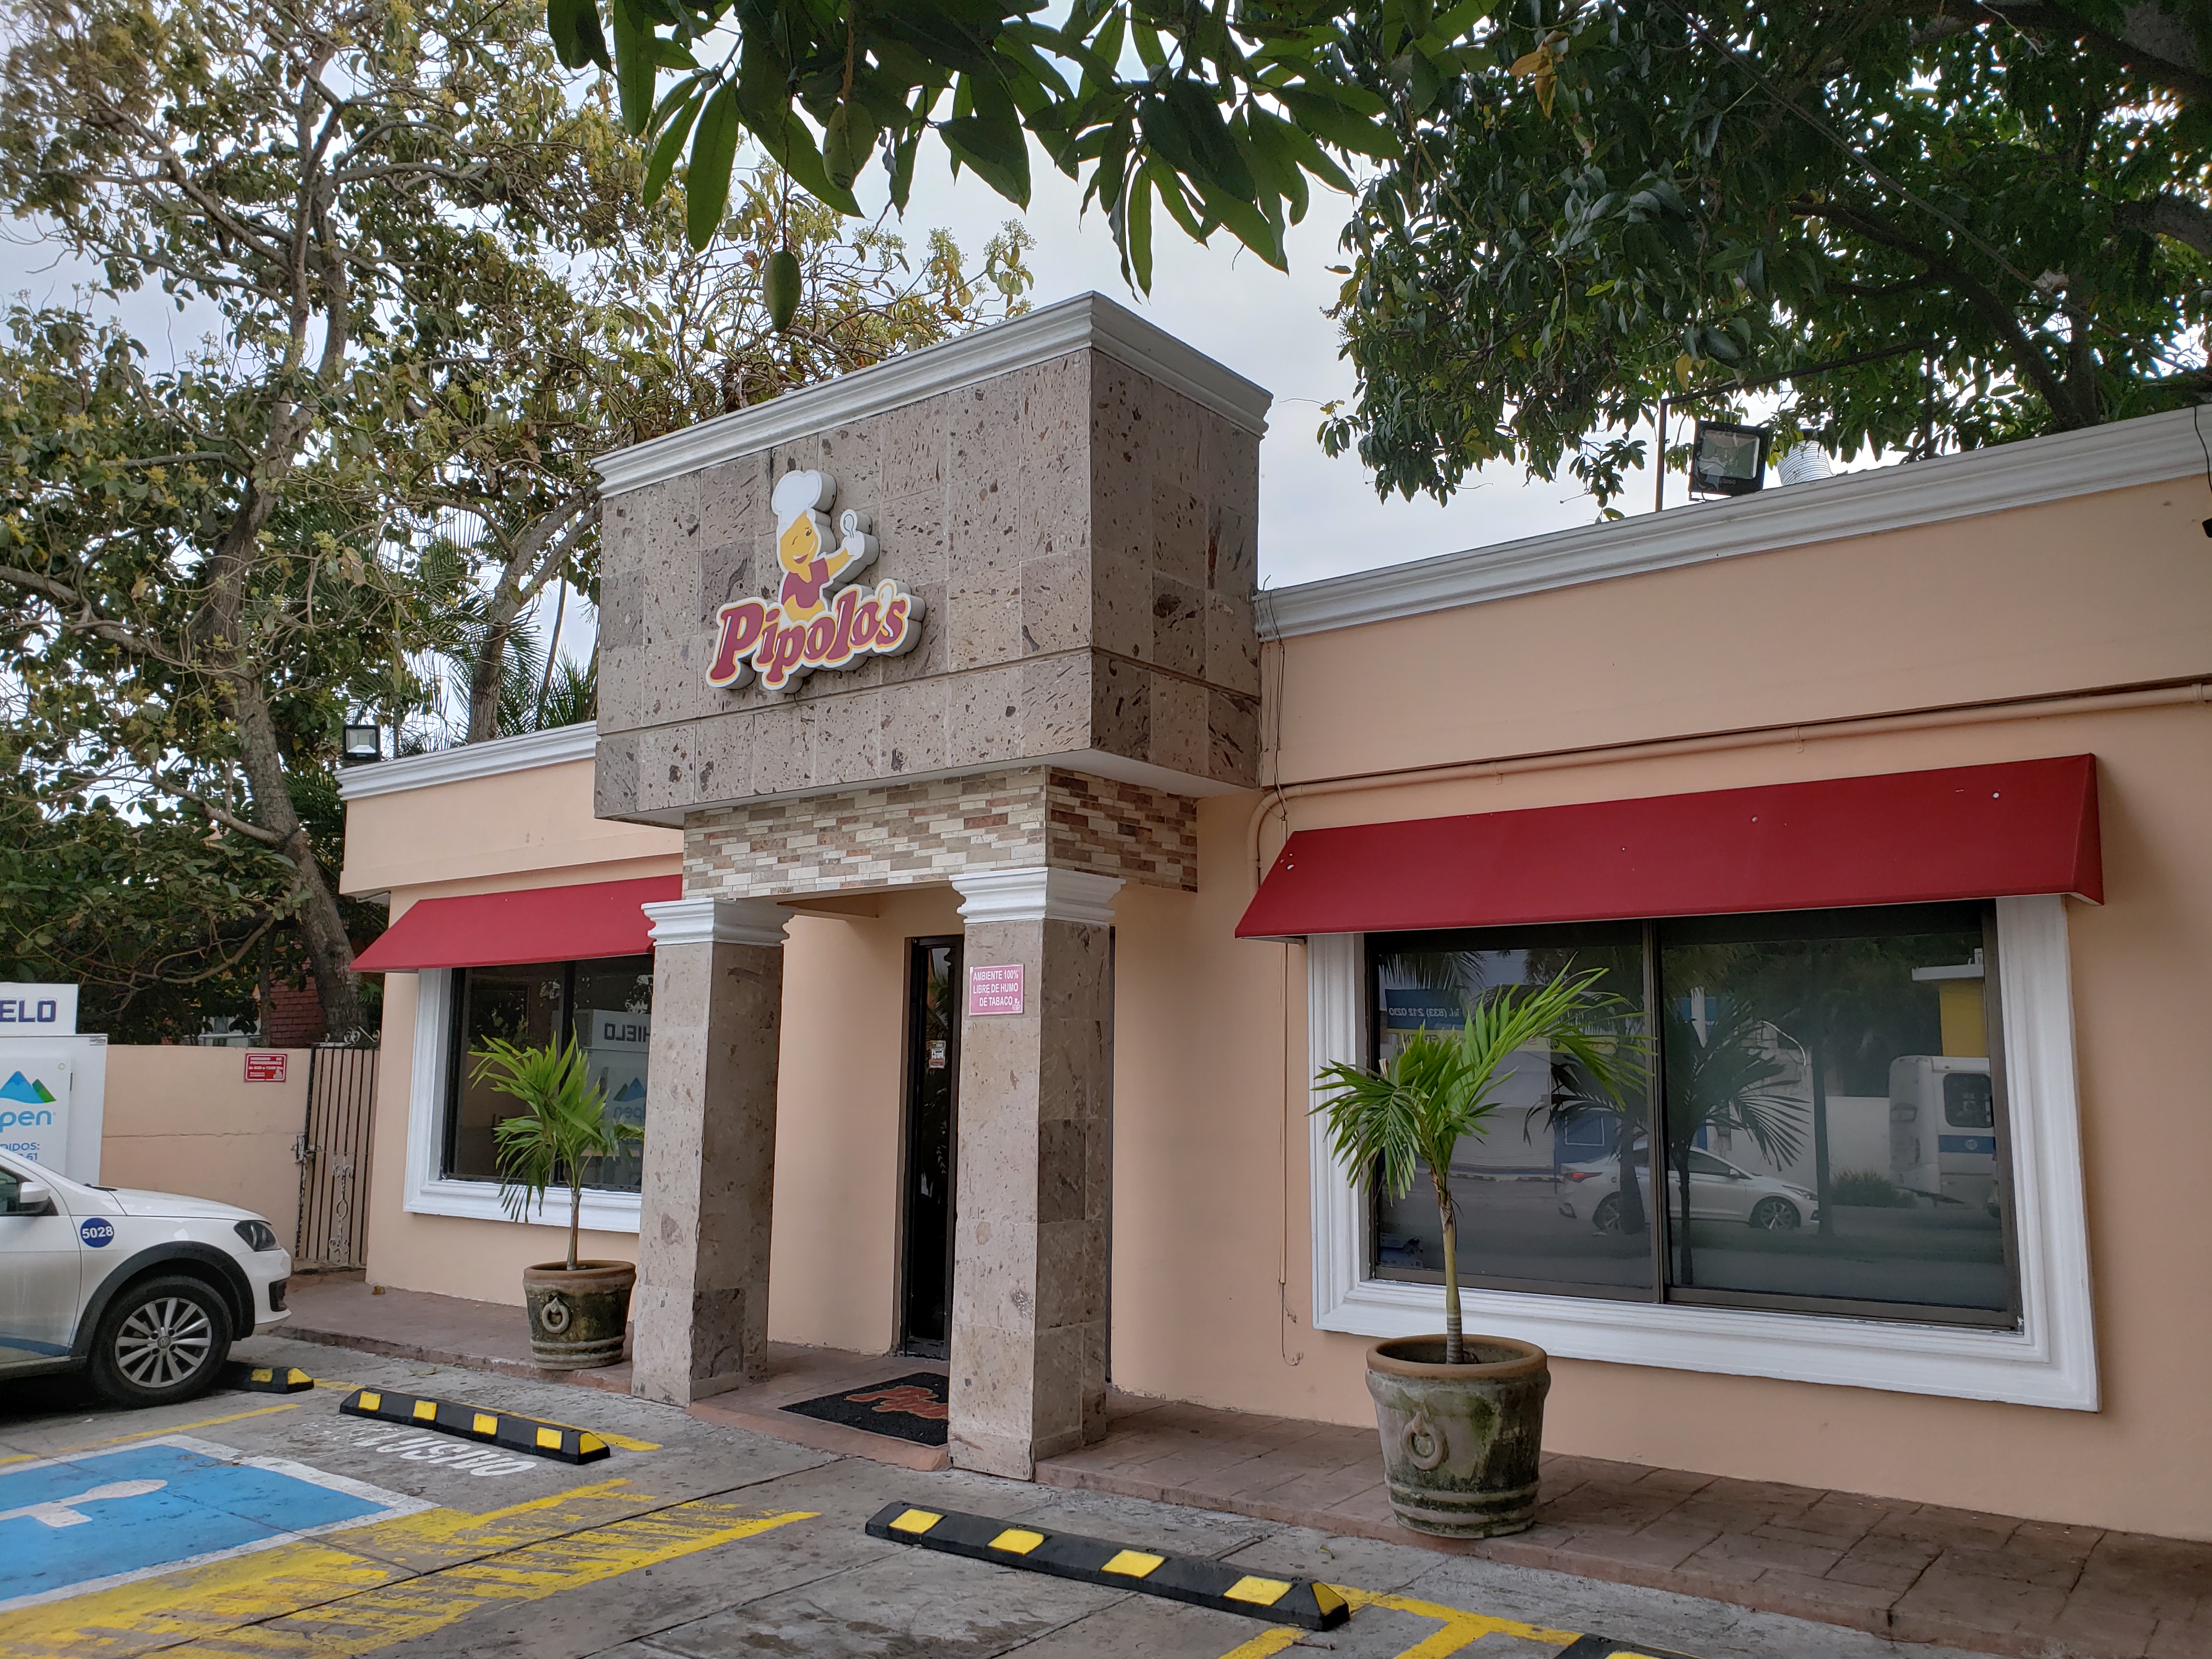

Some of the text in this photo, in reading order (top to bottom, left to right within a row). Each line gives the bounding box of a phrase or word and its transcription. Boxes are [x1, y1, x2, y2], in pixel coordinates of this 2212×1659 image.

[973, 969, 1019, 981] AMBIENTE 100%
[973, 983, 1018, 994] LIBRE DE HUMO
[979, 996, 1013, 1006] DE TABACO
[0, 1000, 57, 1023] ELO
[82, 1226, 114, 1239] 5028
